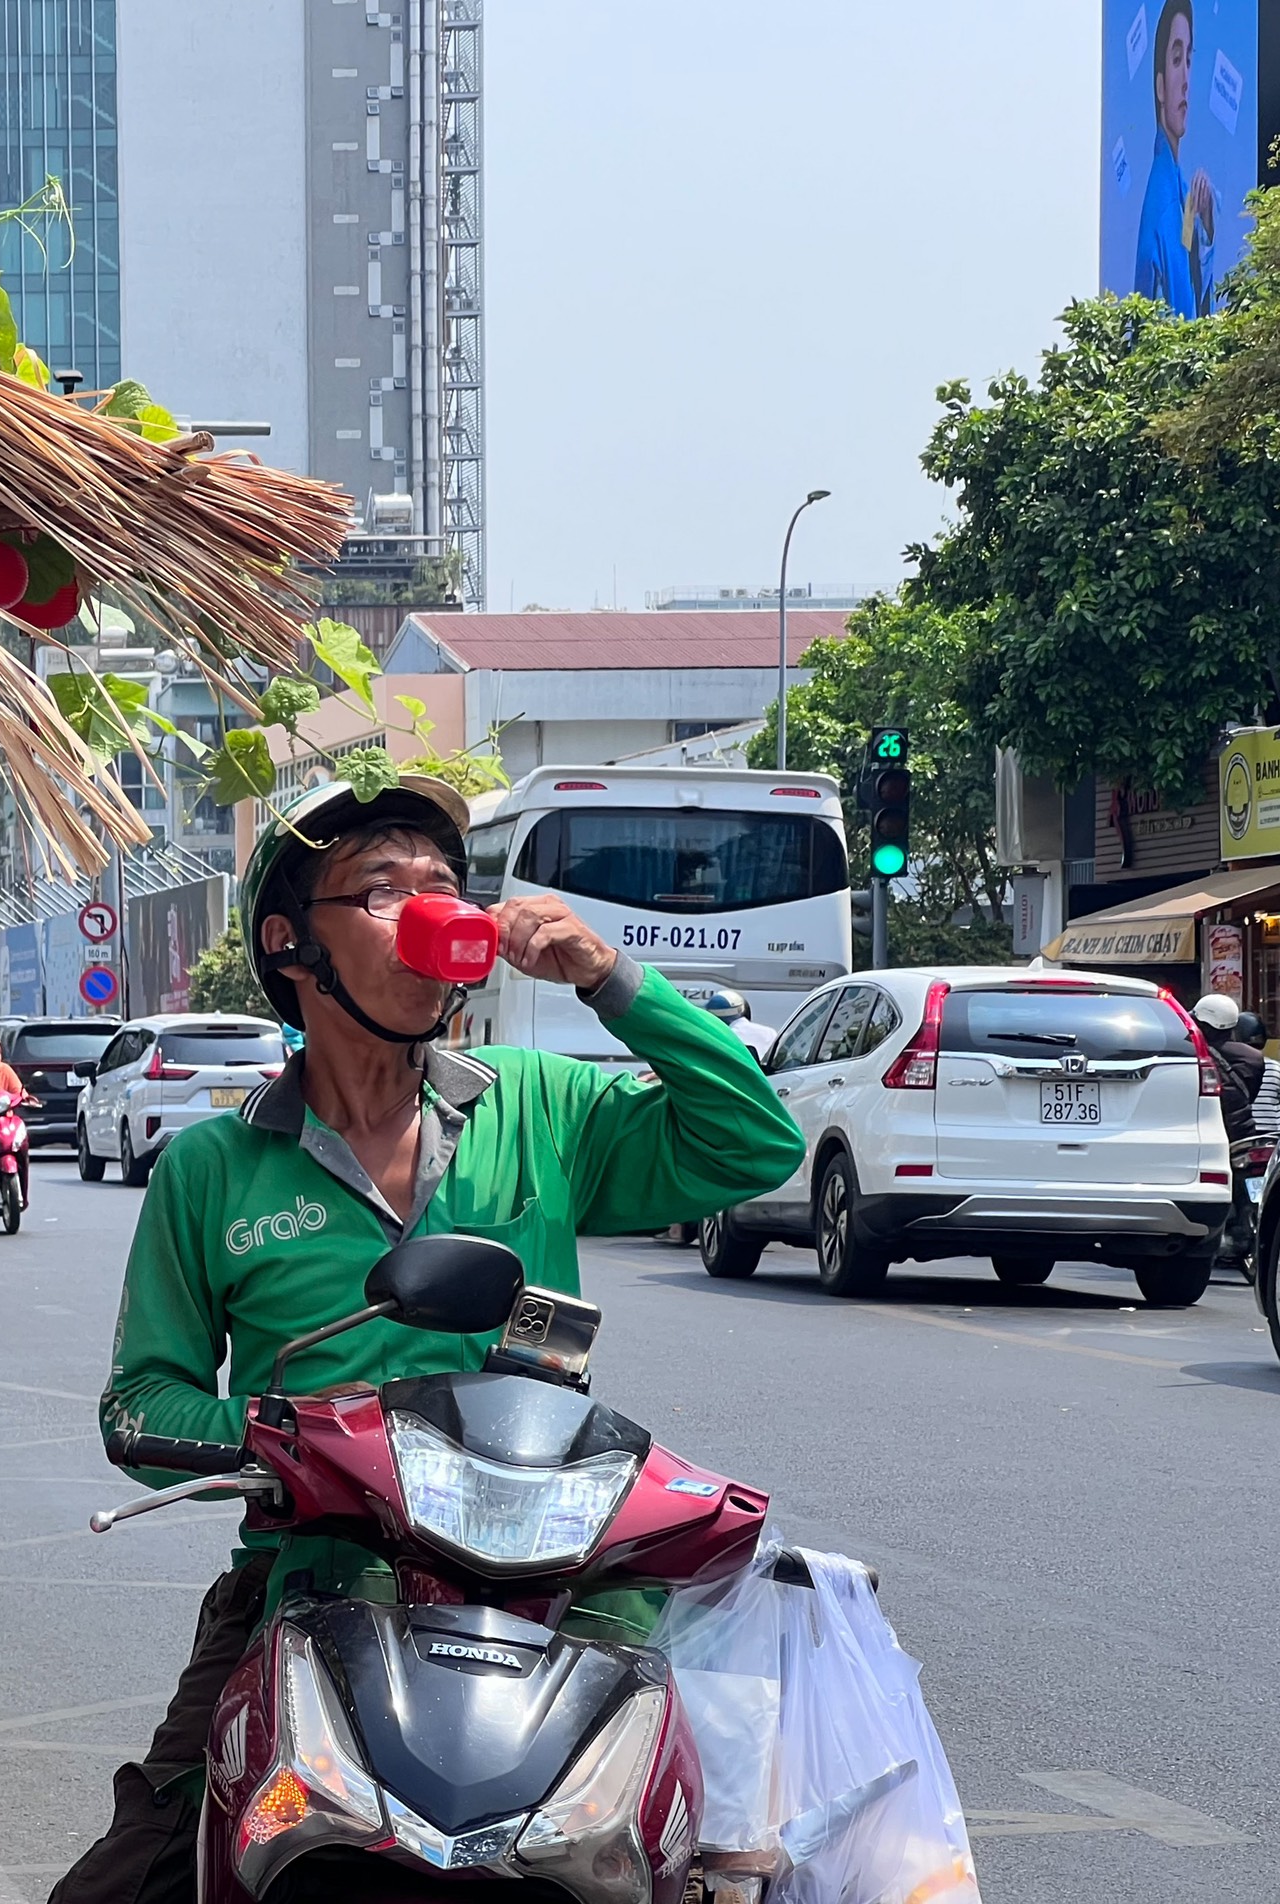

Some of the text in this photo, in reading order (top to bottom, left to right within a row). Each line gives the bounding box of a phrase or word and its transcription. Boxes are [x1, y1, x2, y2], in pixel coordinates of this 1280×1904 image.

[878, 734, 901, 757] 26
[622, 924, 741, 950] 50F-021.07
[1061, 932, 1100, 955] BÁNH
[1114, 934, 1143, 954] CHIM
[1147, 932, 1181, 957] CHẠY
[1054, 1084, 1085, 1101] 51F
[1043, 1103, 1098, 1121] 287.36
[225, 1195, 327, 1255] Grab
[428, 1642, 523, 1670] HONDA
